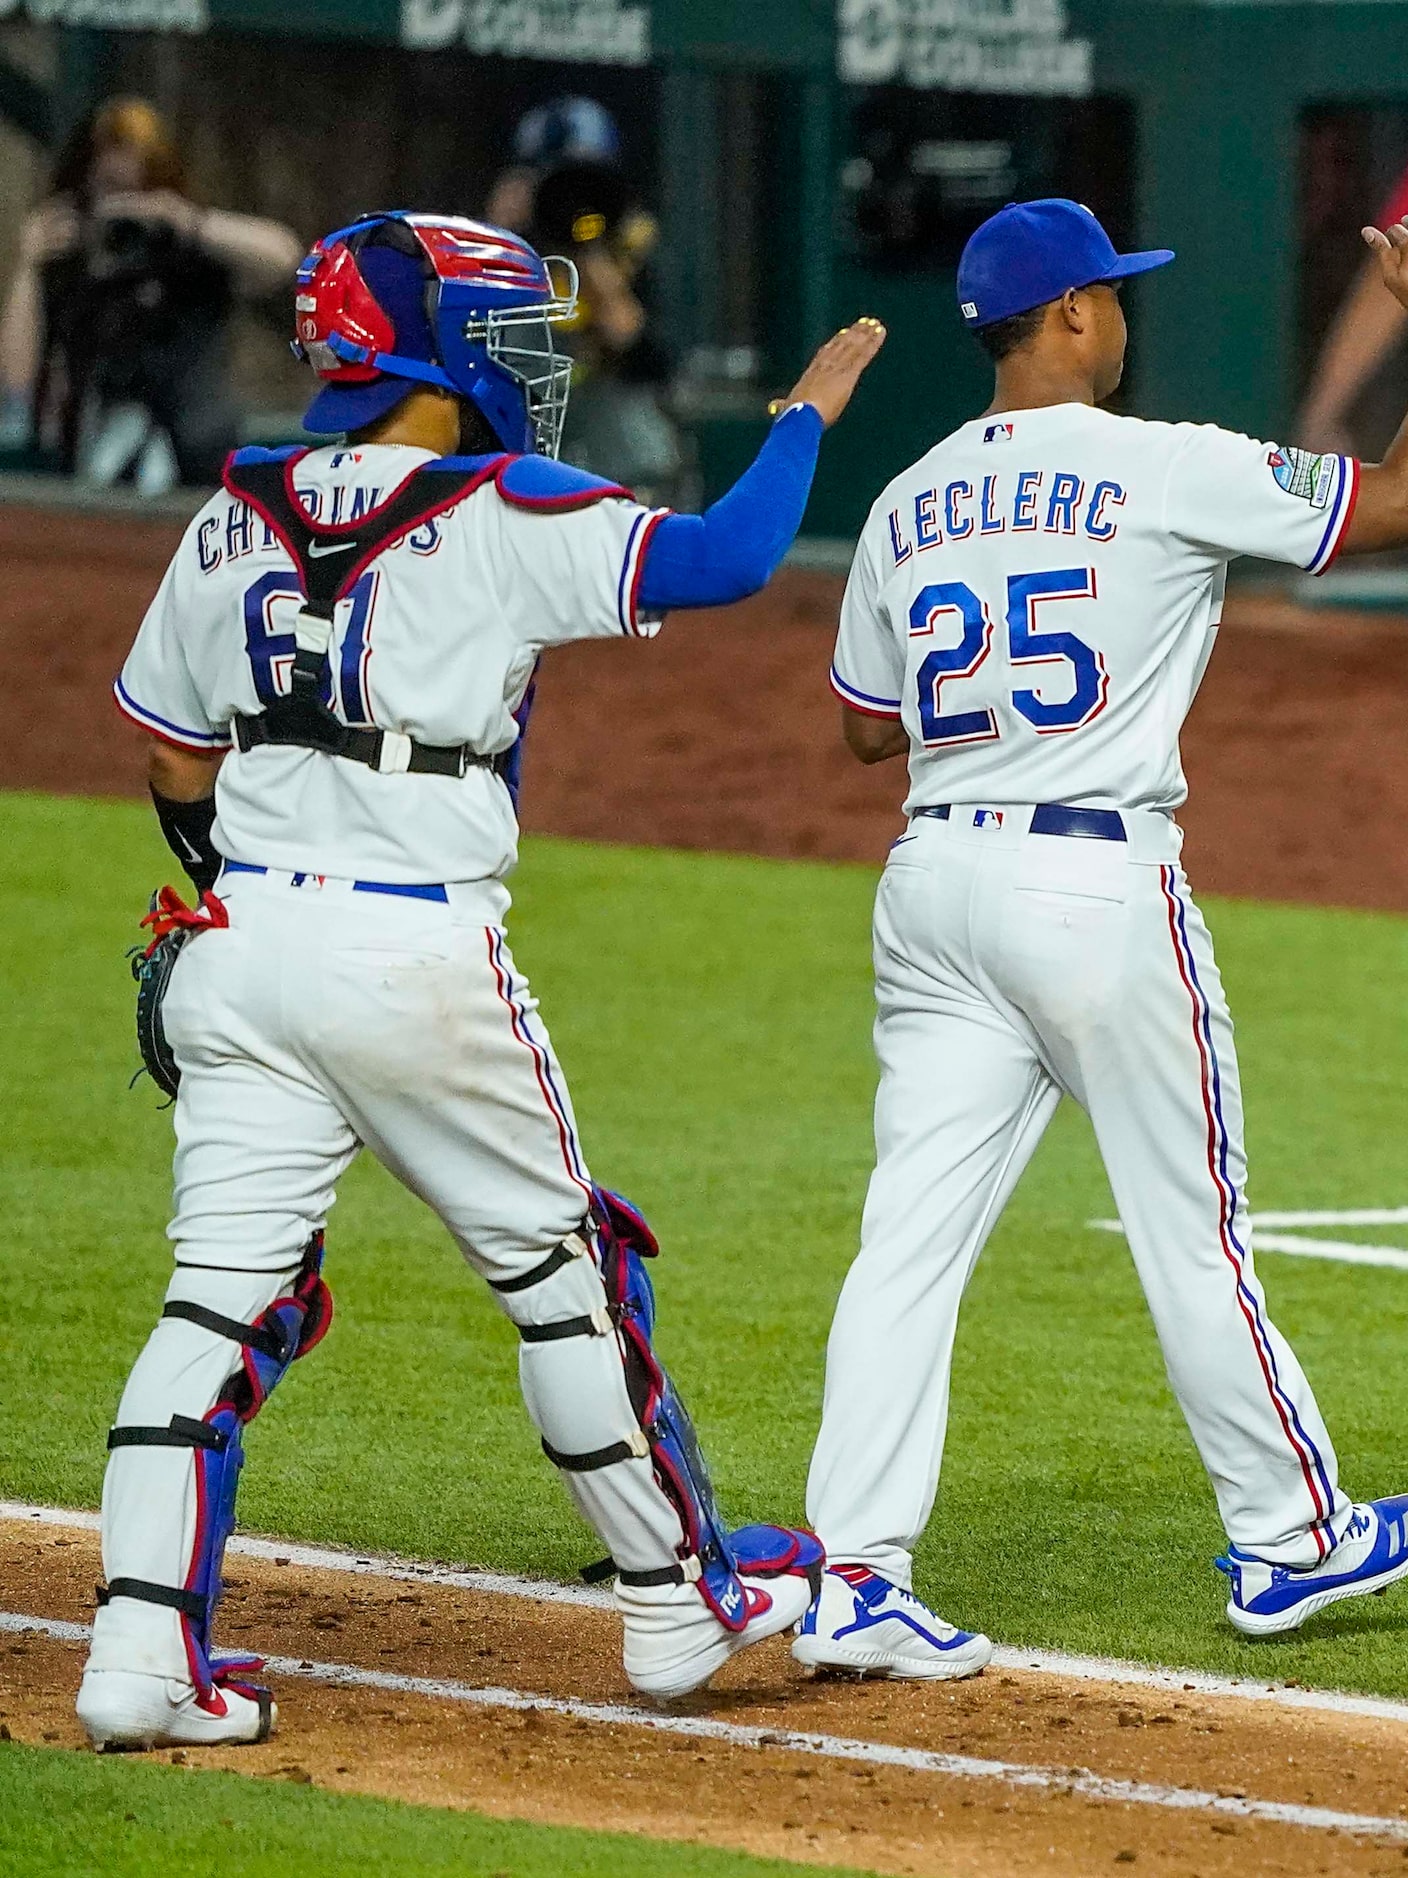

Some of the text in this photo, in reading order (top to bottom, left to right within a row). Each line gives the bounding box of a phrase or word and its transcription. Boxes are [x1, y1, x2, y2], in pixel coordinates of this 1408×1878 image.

[888, 471, 1127, 568] LECLERC
[243, 570, 380, 727] 61
[908, 566, 1111, 749] 25
